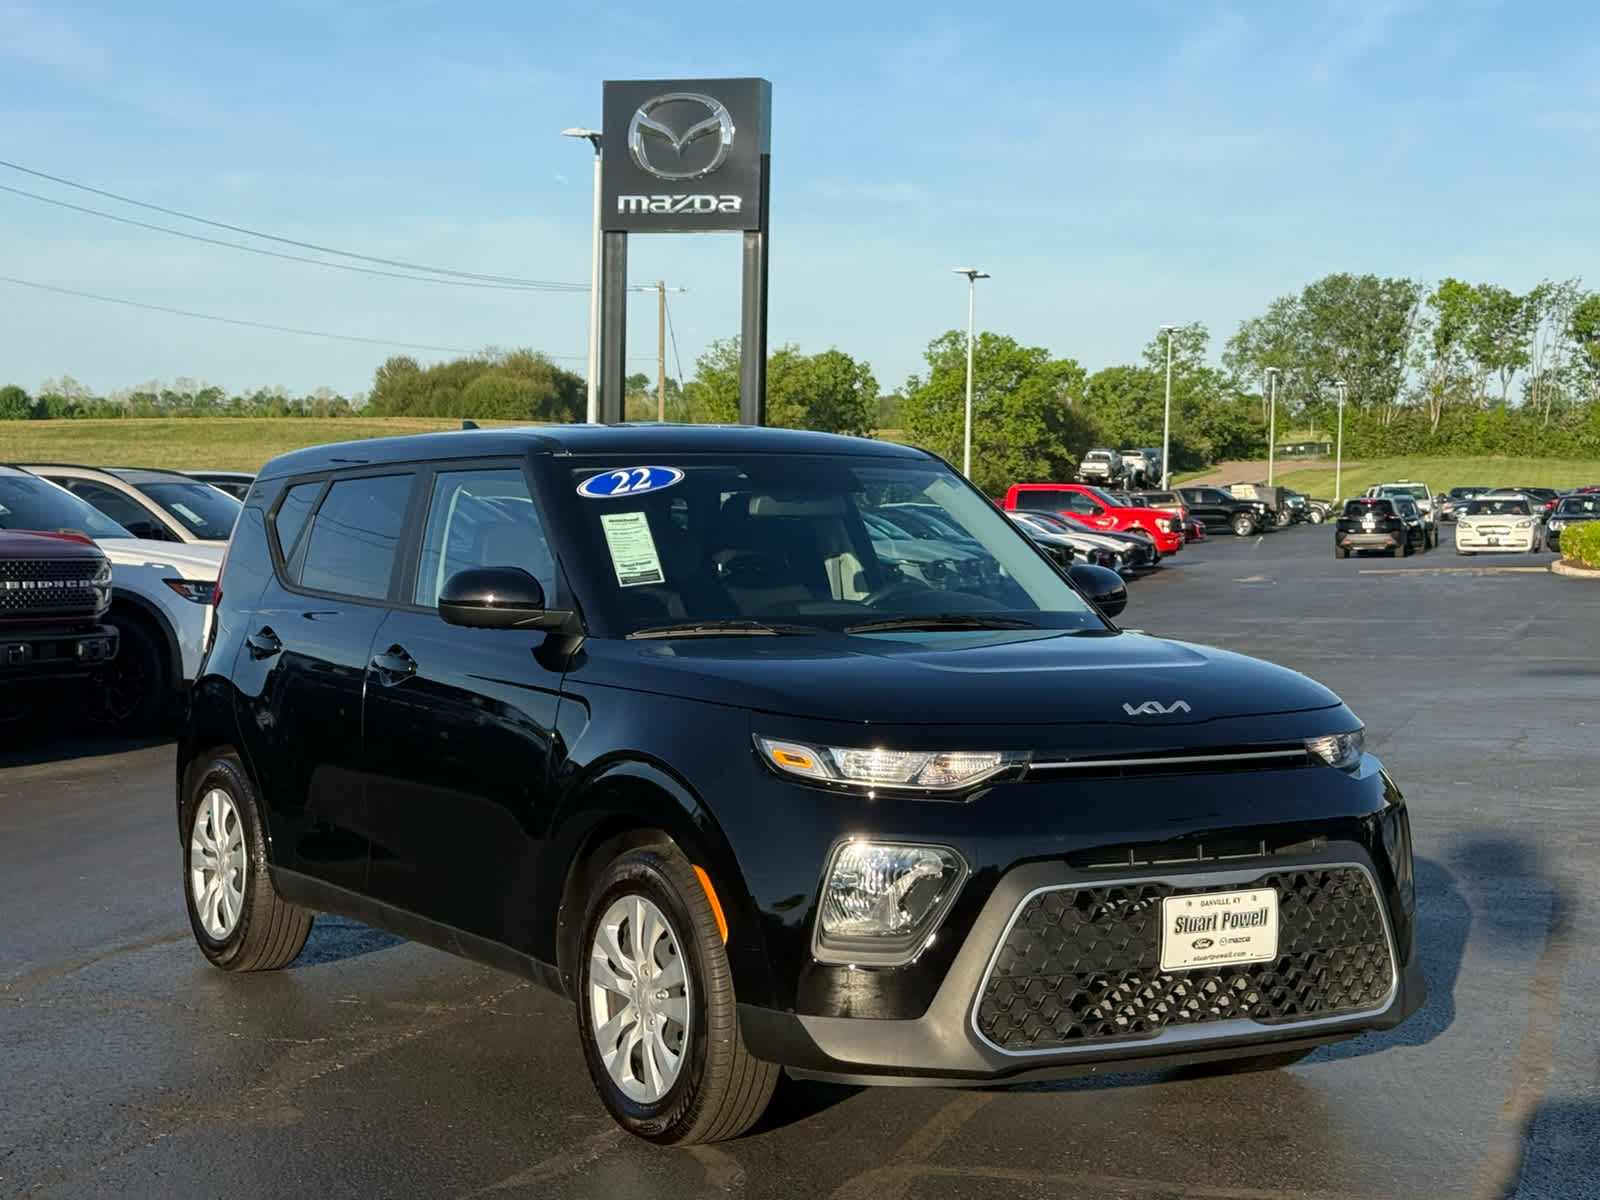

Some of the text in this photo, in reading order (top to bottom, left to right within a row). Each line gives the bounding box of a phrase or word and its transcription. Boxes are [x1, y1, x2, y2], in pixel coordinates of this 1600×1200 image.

[610, 468, 652, 495] 22
[6, 580, 90, 590] BRONCO
[1122, 700, 1192, 715] KIA
[1174, 906, 1269, 935] Stuart Powell
